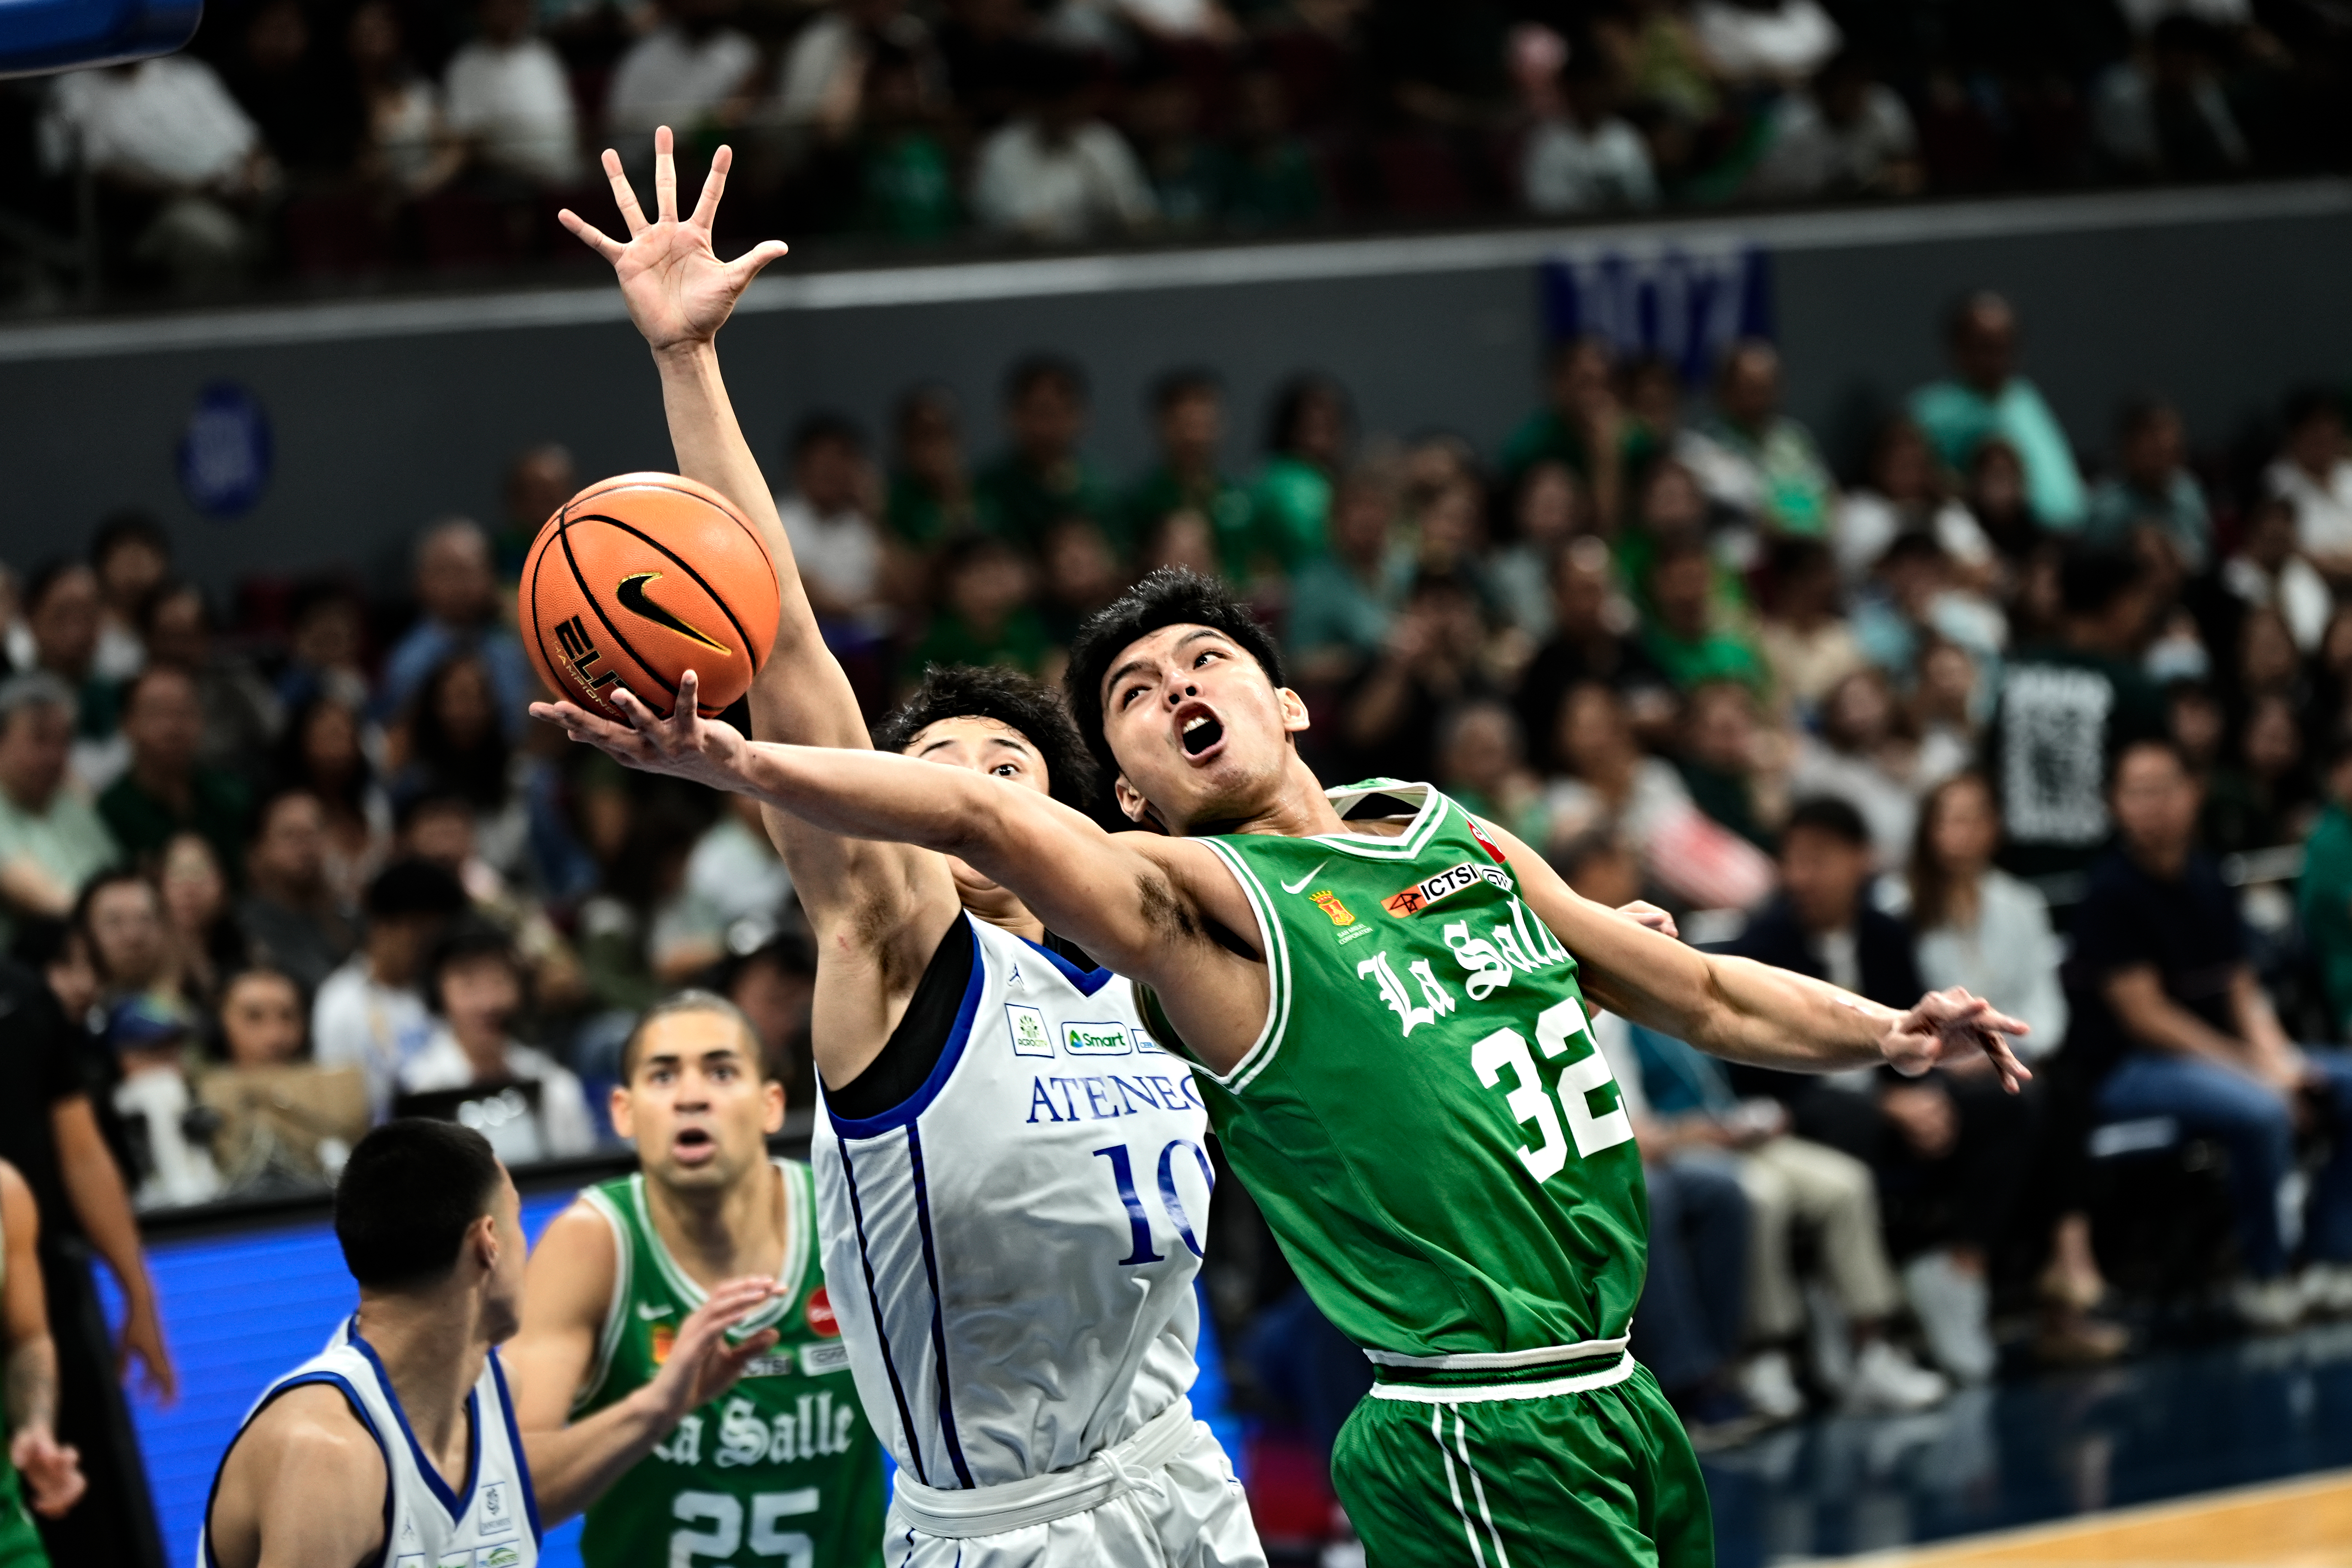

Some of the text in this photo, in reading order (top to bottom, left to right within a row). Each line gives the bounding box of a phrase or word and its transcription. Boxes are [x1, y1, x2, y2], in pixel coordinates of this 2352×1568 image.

[1420, 864, 1478, 901] ICTSI
[1357, 951, 1455, 1037] La
[1083, 1032, 1126, 1047] Smart
[1472, 996, 1634, 1183] 32
[1093, 1139, 1216, 1265] 10
[713, 1390, 855, 1468] Salle
[668, 1487, 820, 1568] 25
